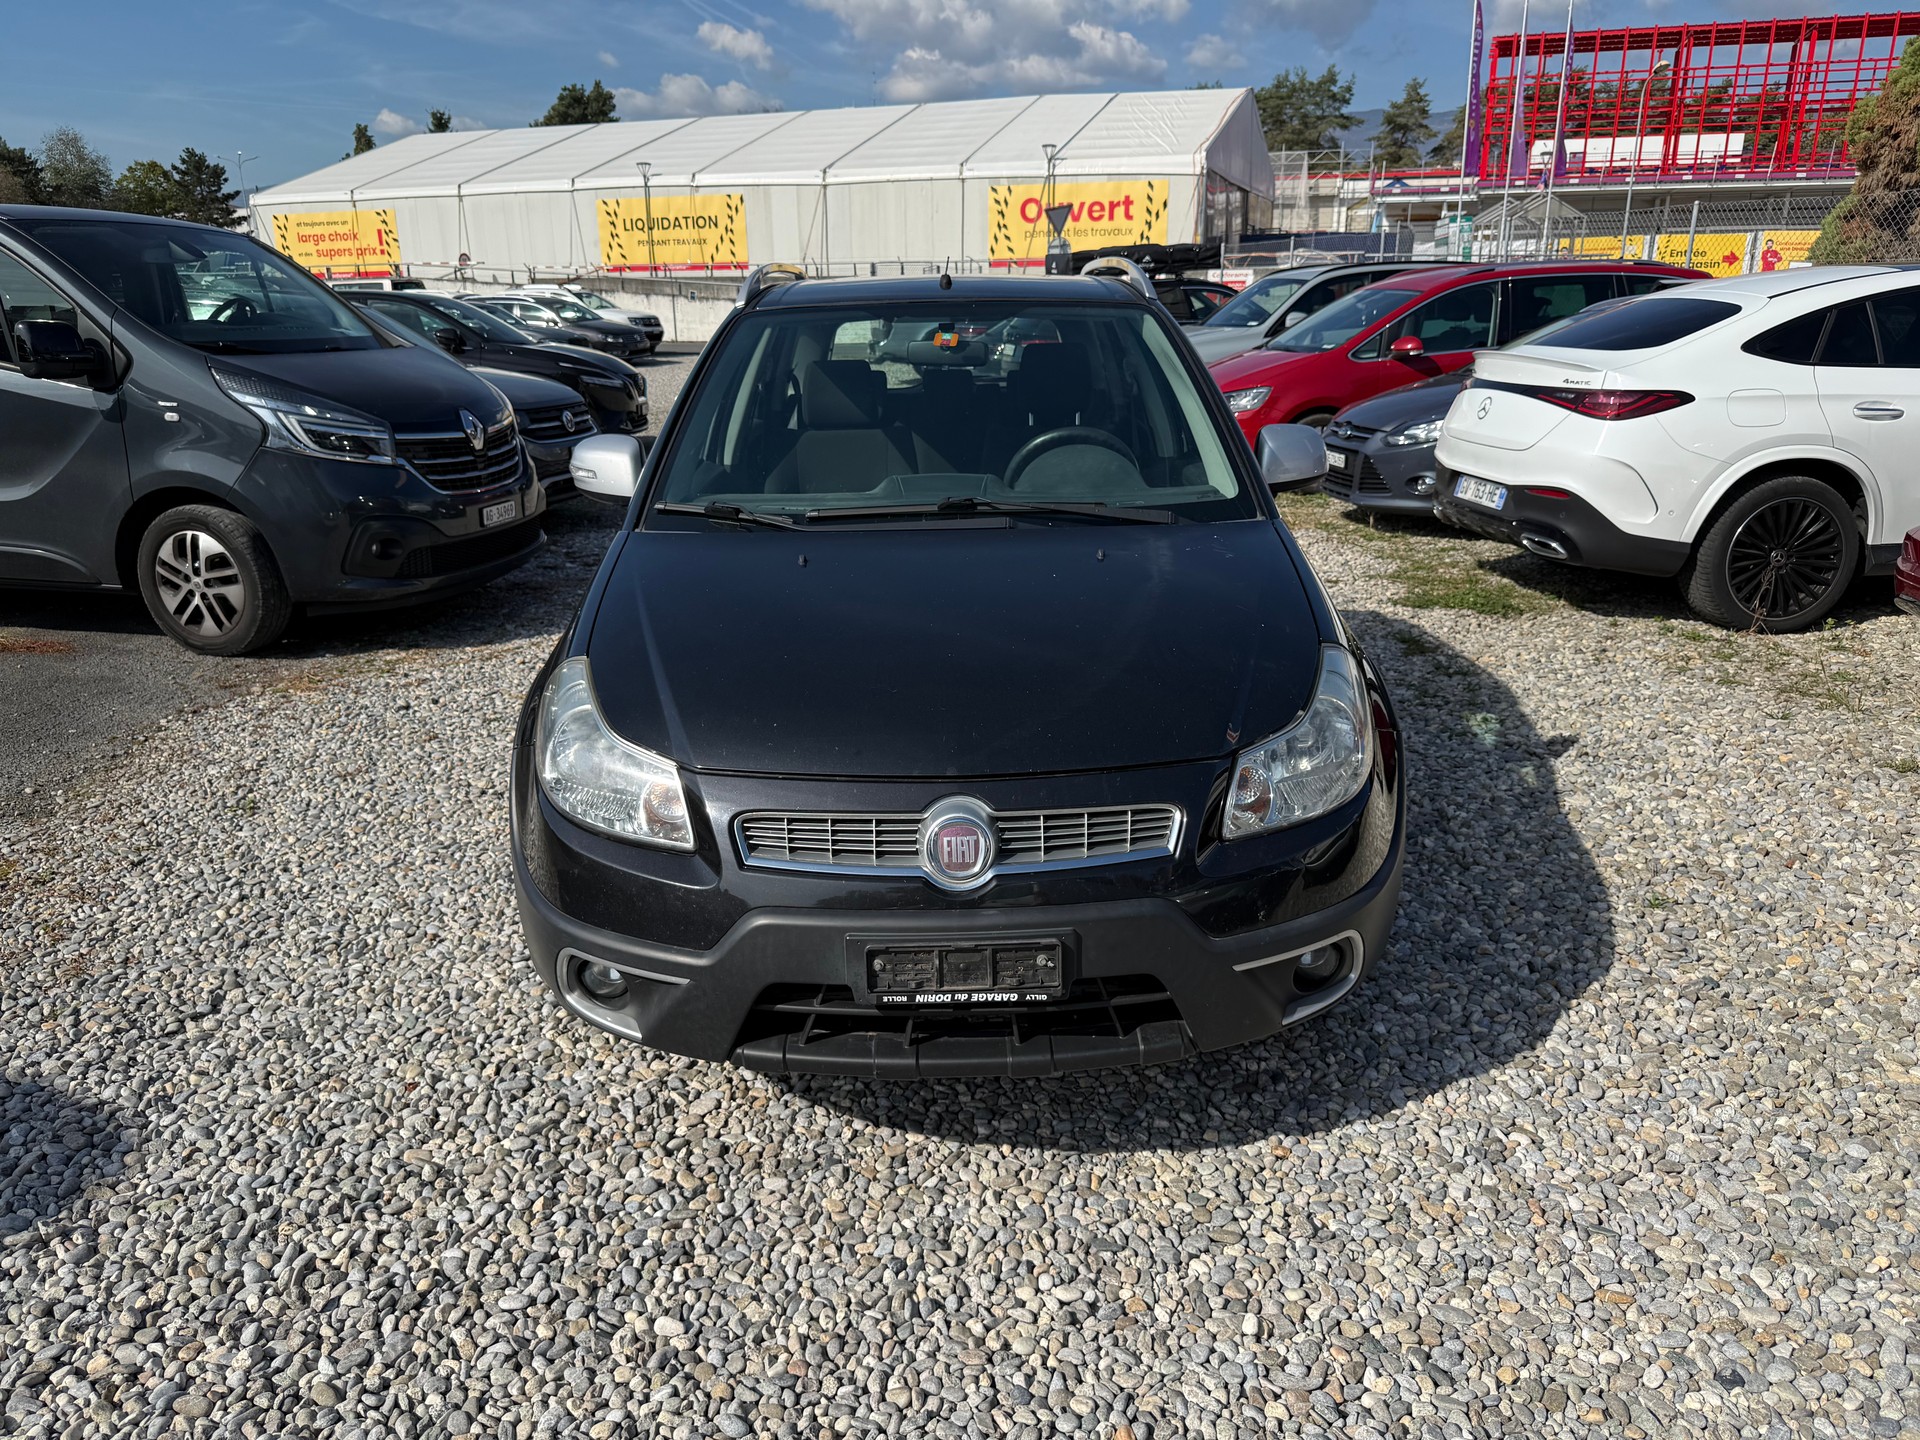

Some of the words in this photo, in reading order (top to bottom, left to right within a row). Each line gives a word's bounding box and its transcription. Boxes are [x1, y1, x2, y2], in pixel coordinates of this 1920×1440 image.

[1020, 195, 1134, 224] Overt
[303, 220, 325, 229] toujours
[623, 215, 719, 233] LIQUIDATION
[297, 231, 326, 246] large
[328, 229, 359, 242] choix
[1072, 227, 1089, 238] les
[1090, 226, 1133, 237] travaux
[637, 238, 671, 248] PENDANT
[672, 238, 708, 247] TRAVAUX
[316, 247, 353, 261] supers
[356, 244, 378, 260] prix
[1669, 247, 1708, 258] Entée
[1211, 271, 1249, 279] Coforama
[1562, 378, 1592, 386] 4MATIC
[1460, 478, 1500, 503] GV-763-HE
[943, 835, 977, 864] FIAT
[915, 994, 952, 1003] DORIN
[954, 993, 968, 1002] du
[971, 993, 1019, 1002] GARAGE
